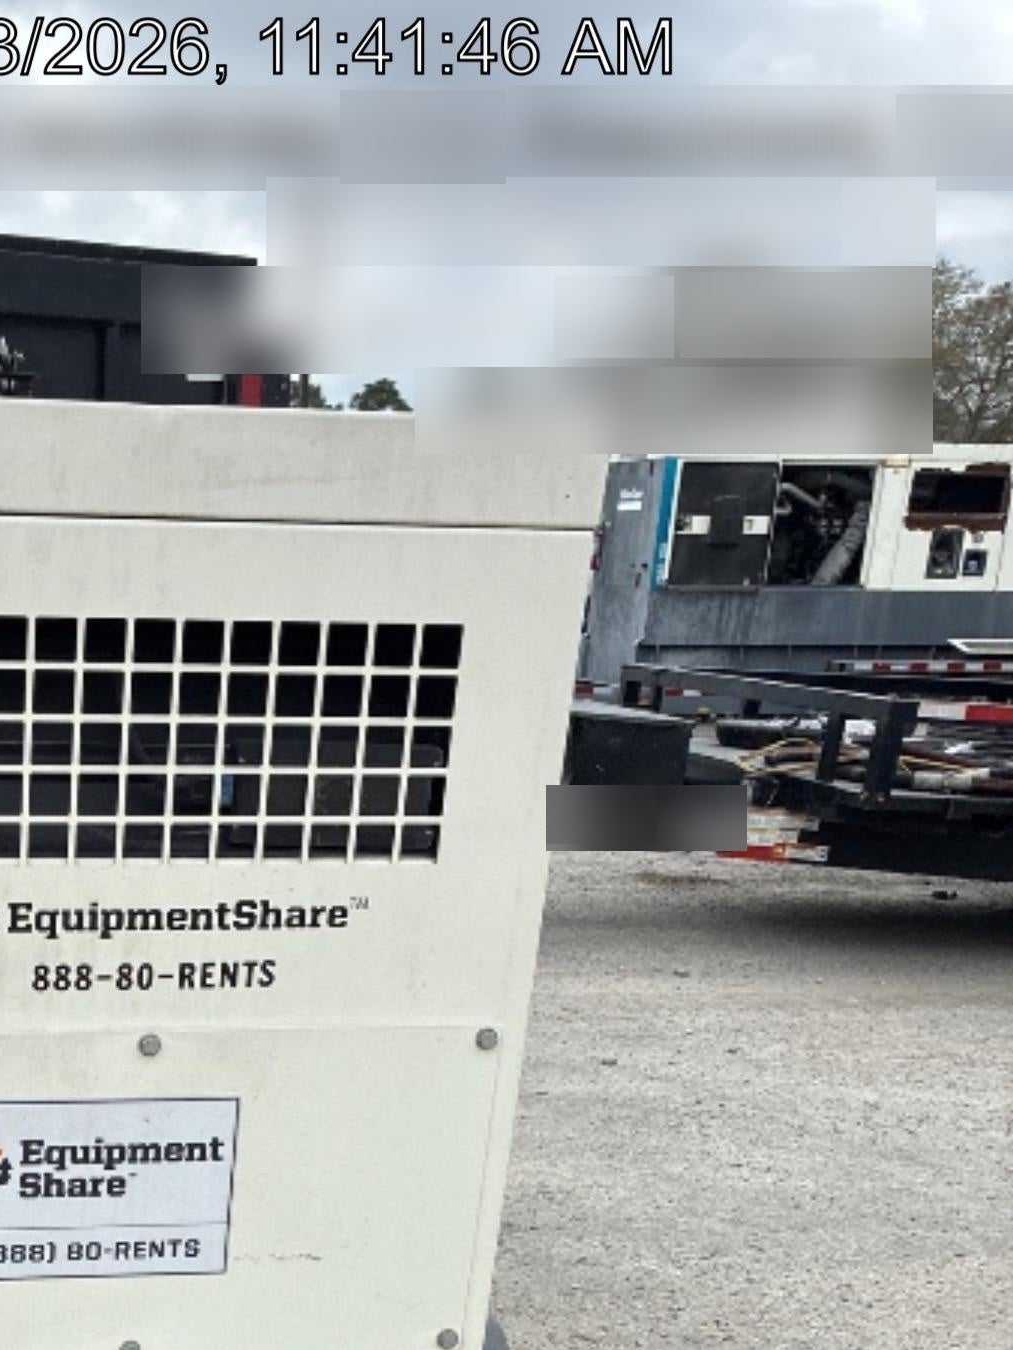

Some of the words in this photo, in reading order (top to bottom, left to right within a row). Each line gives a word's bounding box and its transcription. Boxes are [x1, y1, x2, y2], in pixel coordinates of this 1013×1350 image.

[7, 899, 349, 939] EquipmentShare
[31, 960, 277, 991] 888-80-RENTS
[19, 1136, 225, 1171] Equipment
[19, 1173, 127, 1199] Share
[67, 1239, 202, 1261] 80-RENTS
